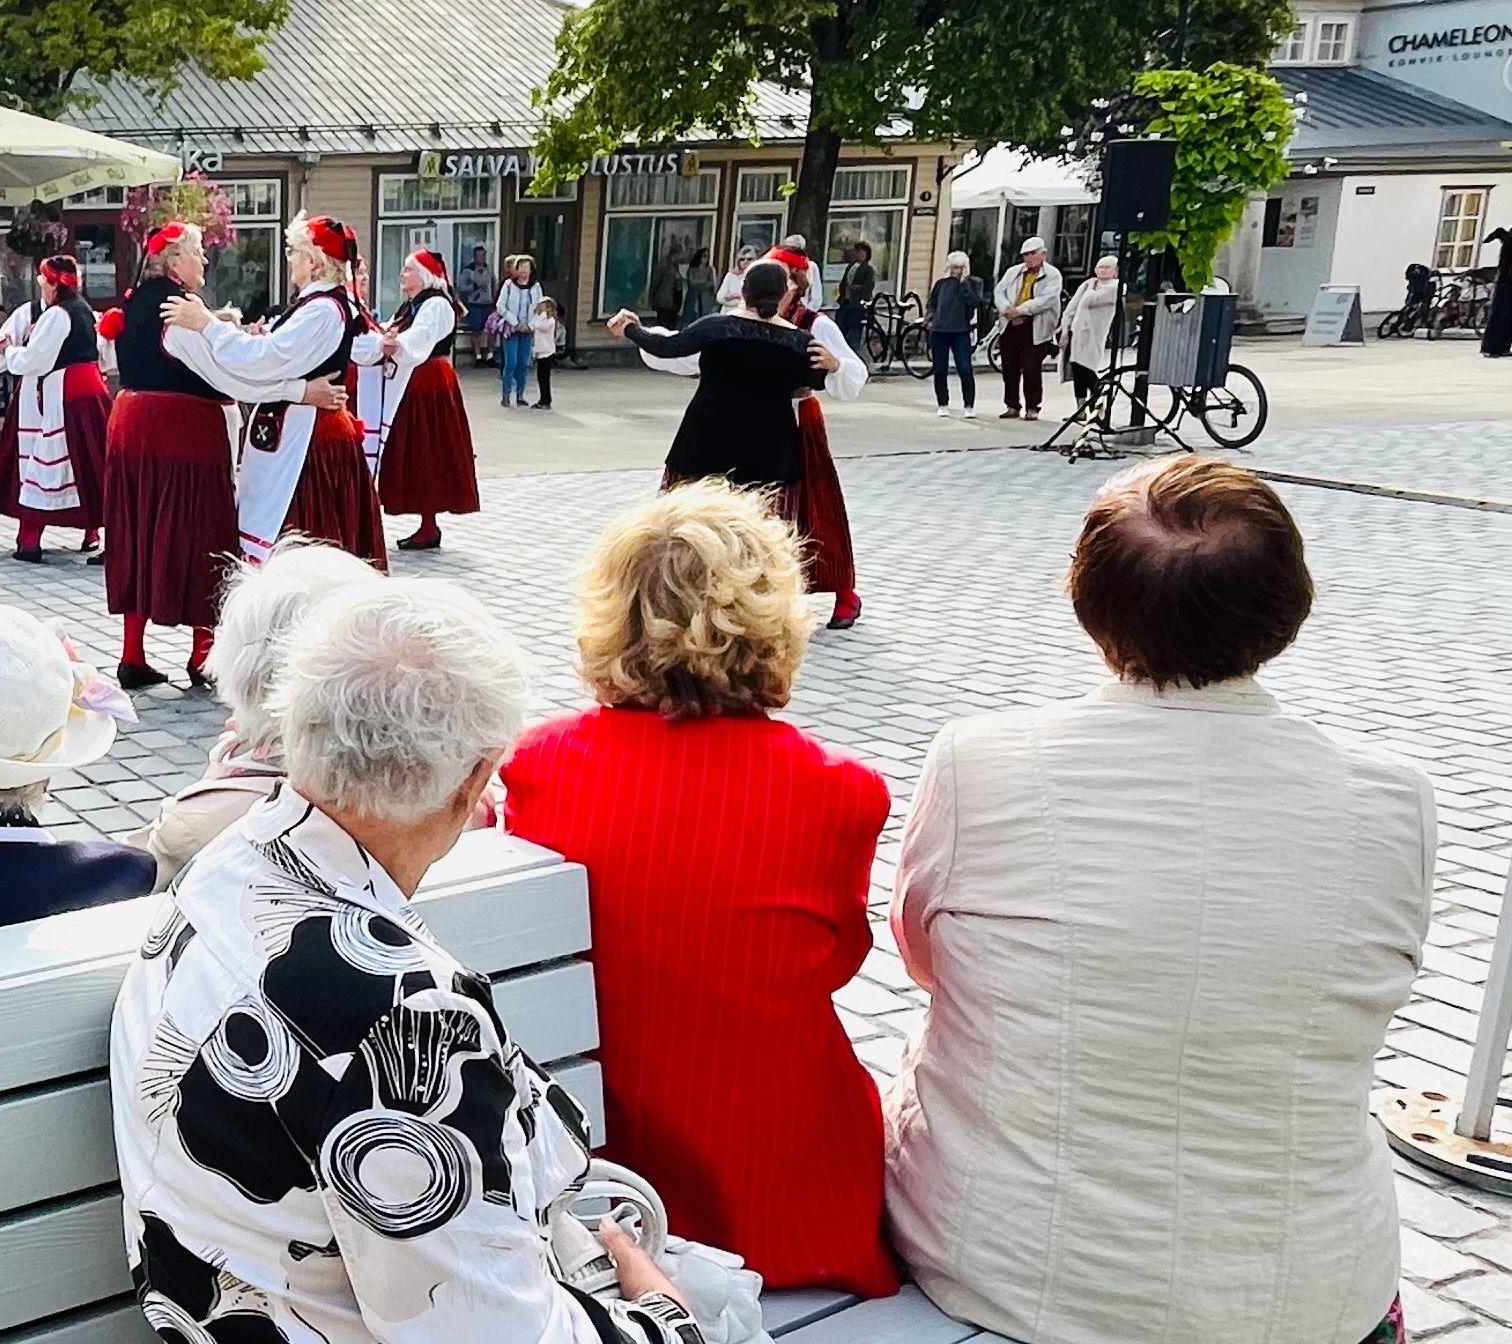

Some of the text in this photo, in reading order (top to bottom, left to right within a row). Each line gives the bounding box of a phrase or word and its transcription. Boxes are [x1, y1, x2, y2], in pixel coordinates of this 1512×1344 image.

[1388, 24, 1512, 54] CHAMELEON
[444, 152, 678, 176] SALVA KLUSTUS
